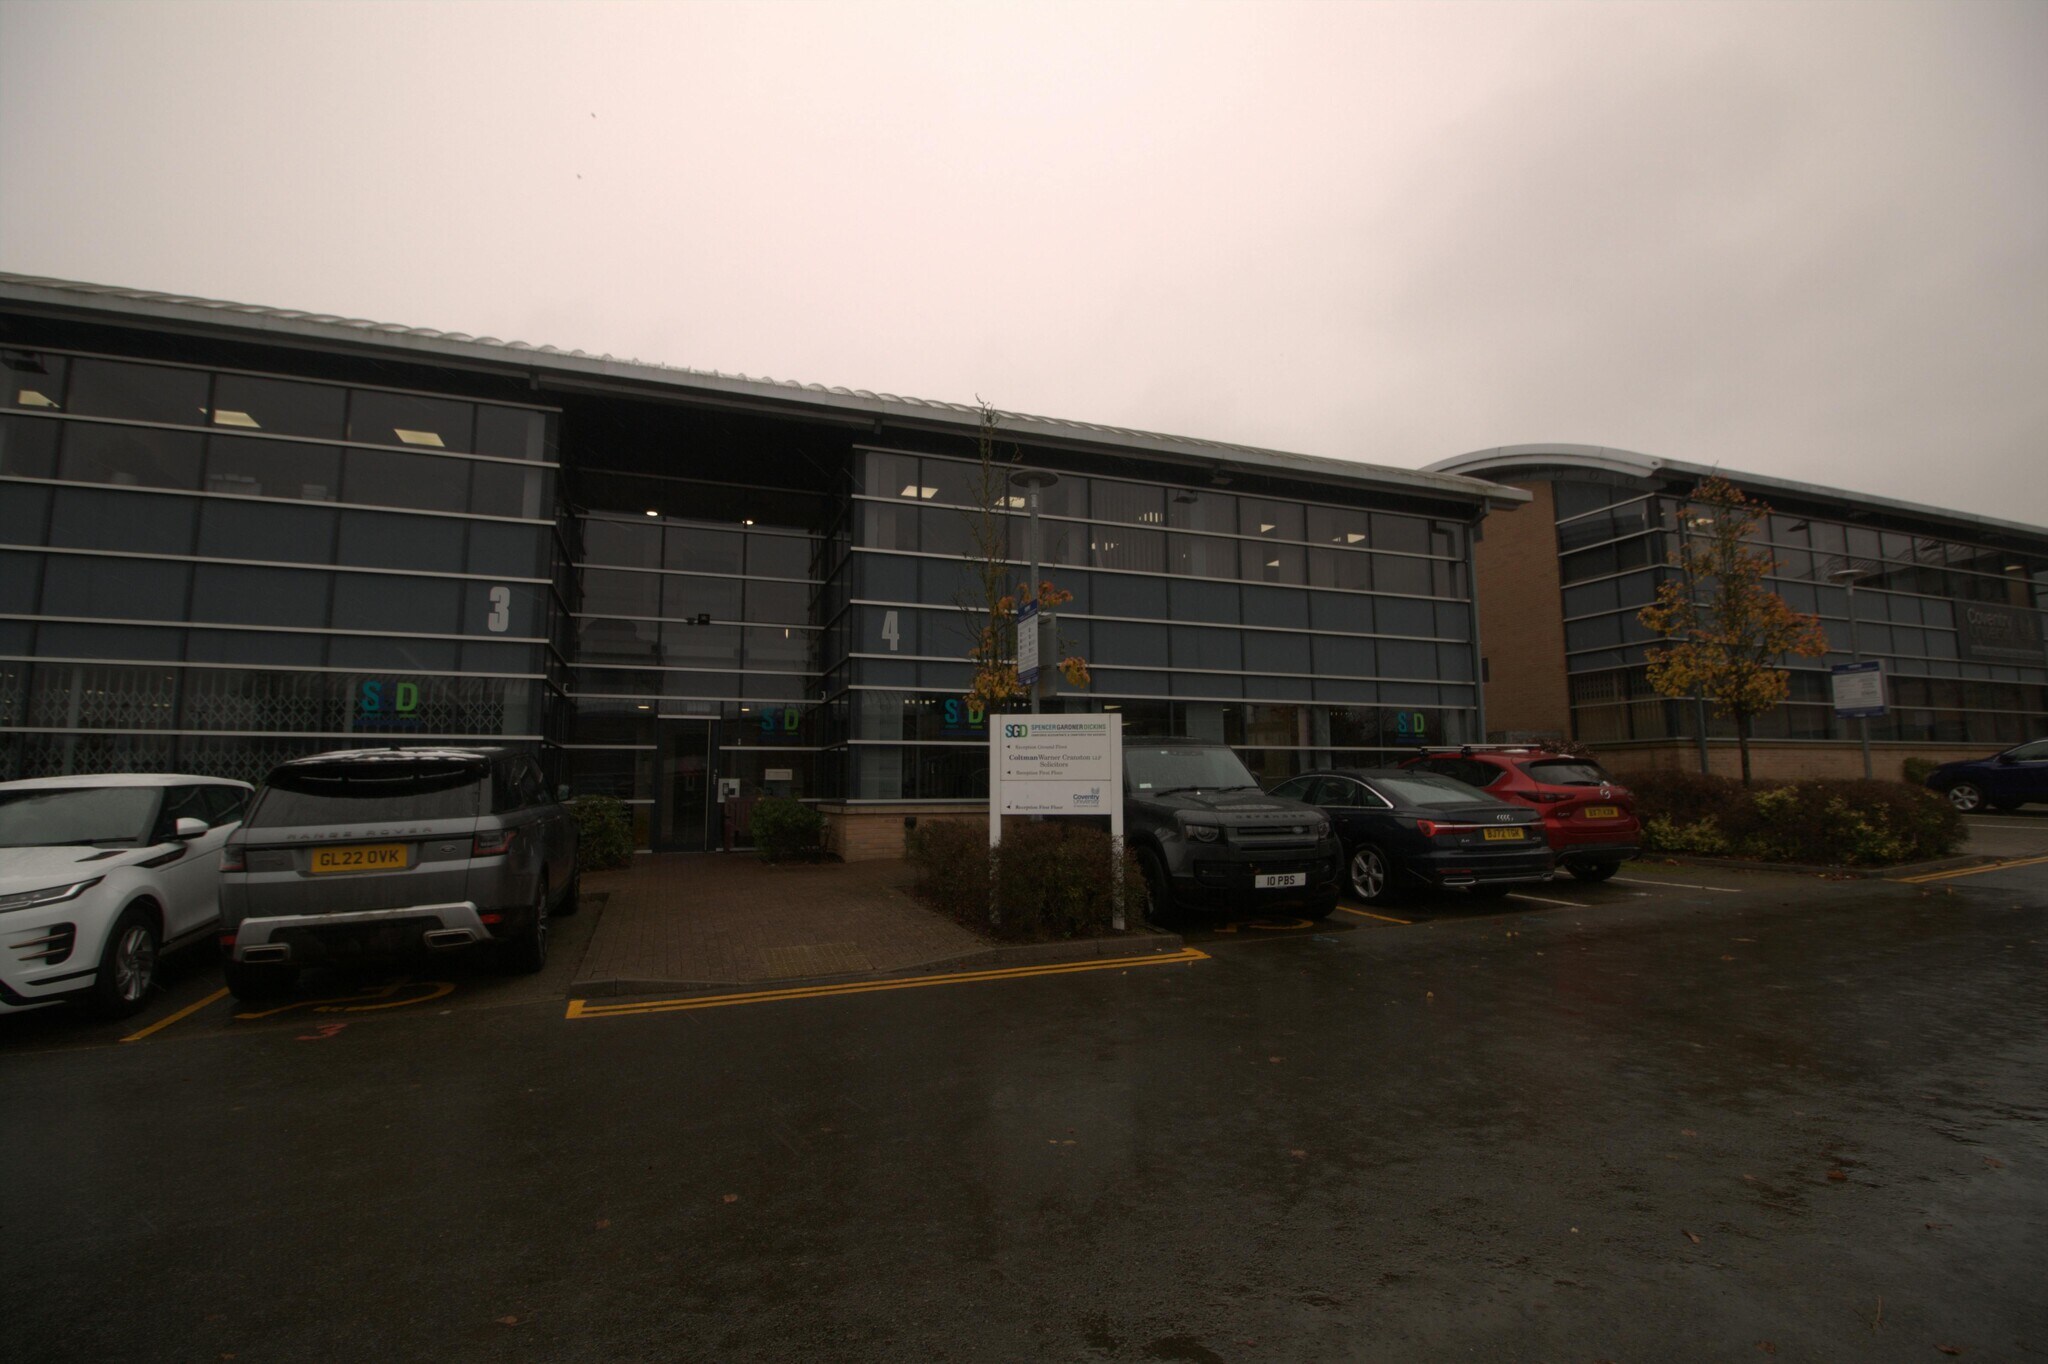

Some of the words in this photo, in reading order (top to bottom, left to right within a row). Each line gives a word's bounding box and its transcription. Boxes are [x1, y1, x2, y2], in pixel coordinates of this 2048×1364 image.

[488, 586, 511, 632] 3
[882, 611, 900, 651] 4
[361, 681, 418, 711] SD
[761, 707, 799, 730] SD
[945, 698, 984, 723] SD
[1005, 724, 1028, 738] SGD
[1398, 712, 1425, 733] SD
[287, 831, 353, 840] RANGE
[366, 826, 434, 836] ROVER
[320, 851, 363, 866] GL22
[367, 849, 399, 864] OVK
[1278, 875, 1295, 885] PBS
